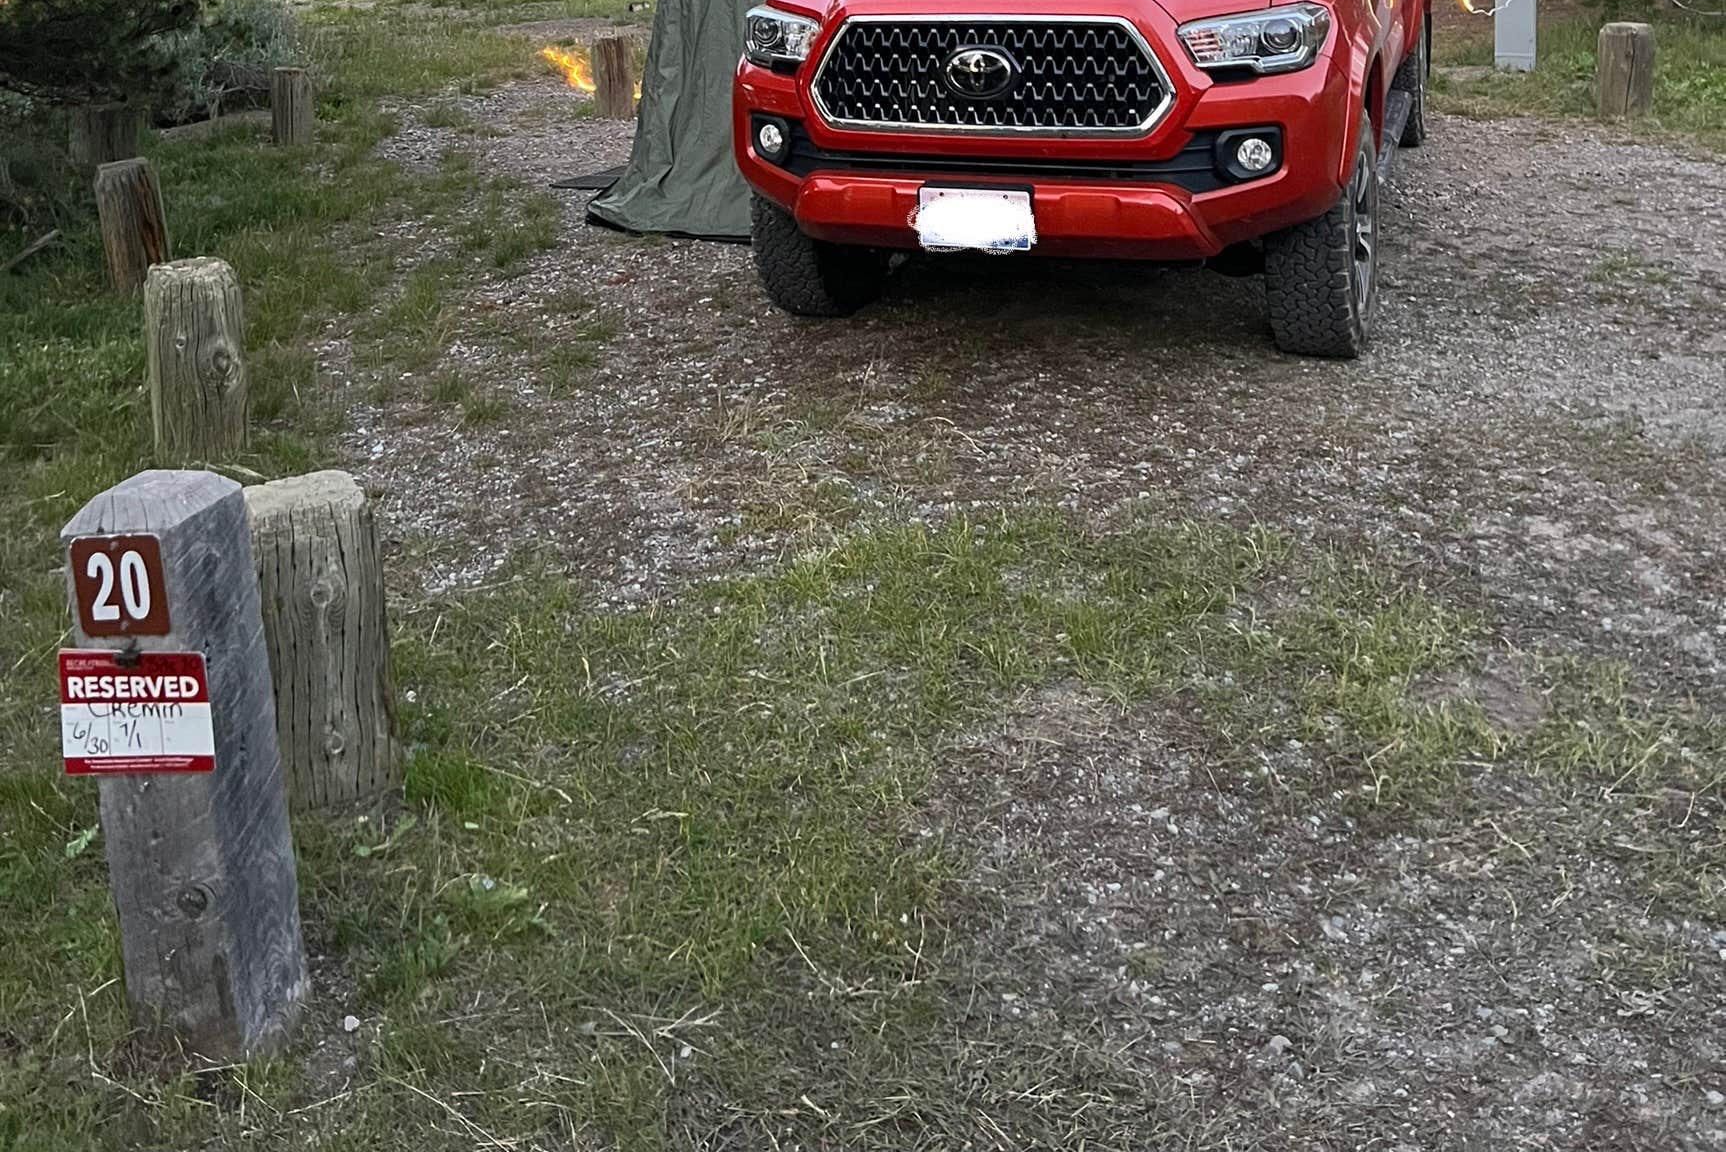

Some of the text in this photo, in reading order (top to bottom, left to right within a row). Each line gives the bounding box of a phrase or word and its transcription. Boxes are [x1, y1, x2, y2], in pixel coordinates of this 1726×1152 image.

[87, 550, 150, 621] 20
[67, 676, 200, 699] RESERVED
[73, 719, 143, 755] 6/30 7/1
